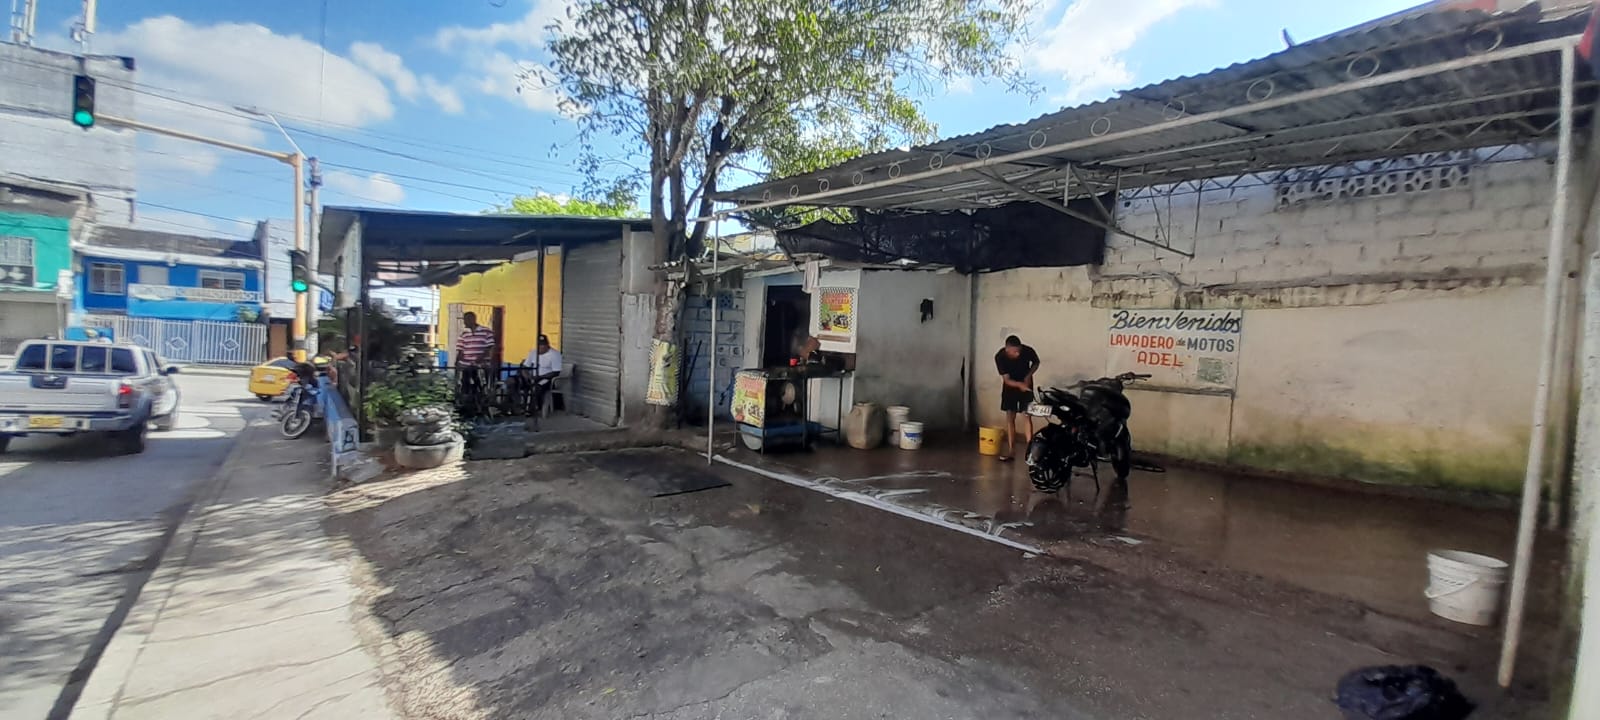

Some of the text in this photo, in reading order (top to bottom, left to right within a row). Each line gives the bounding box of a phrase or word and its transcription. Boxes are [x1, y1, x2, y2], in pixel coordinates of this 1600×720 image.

[1110, 333, 1235, 352] LAVADERO de MOTOS
